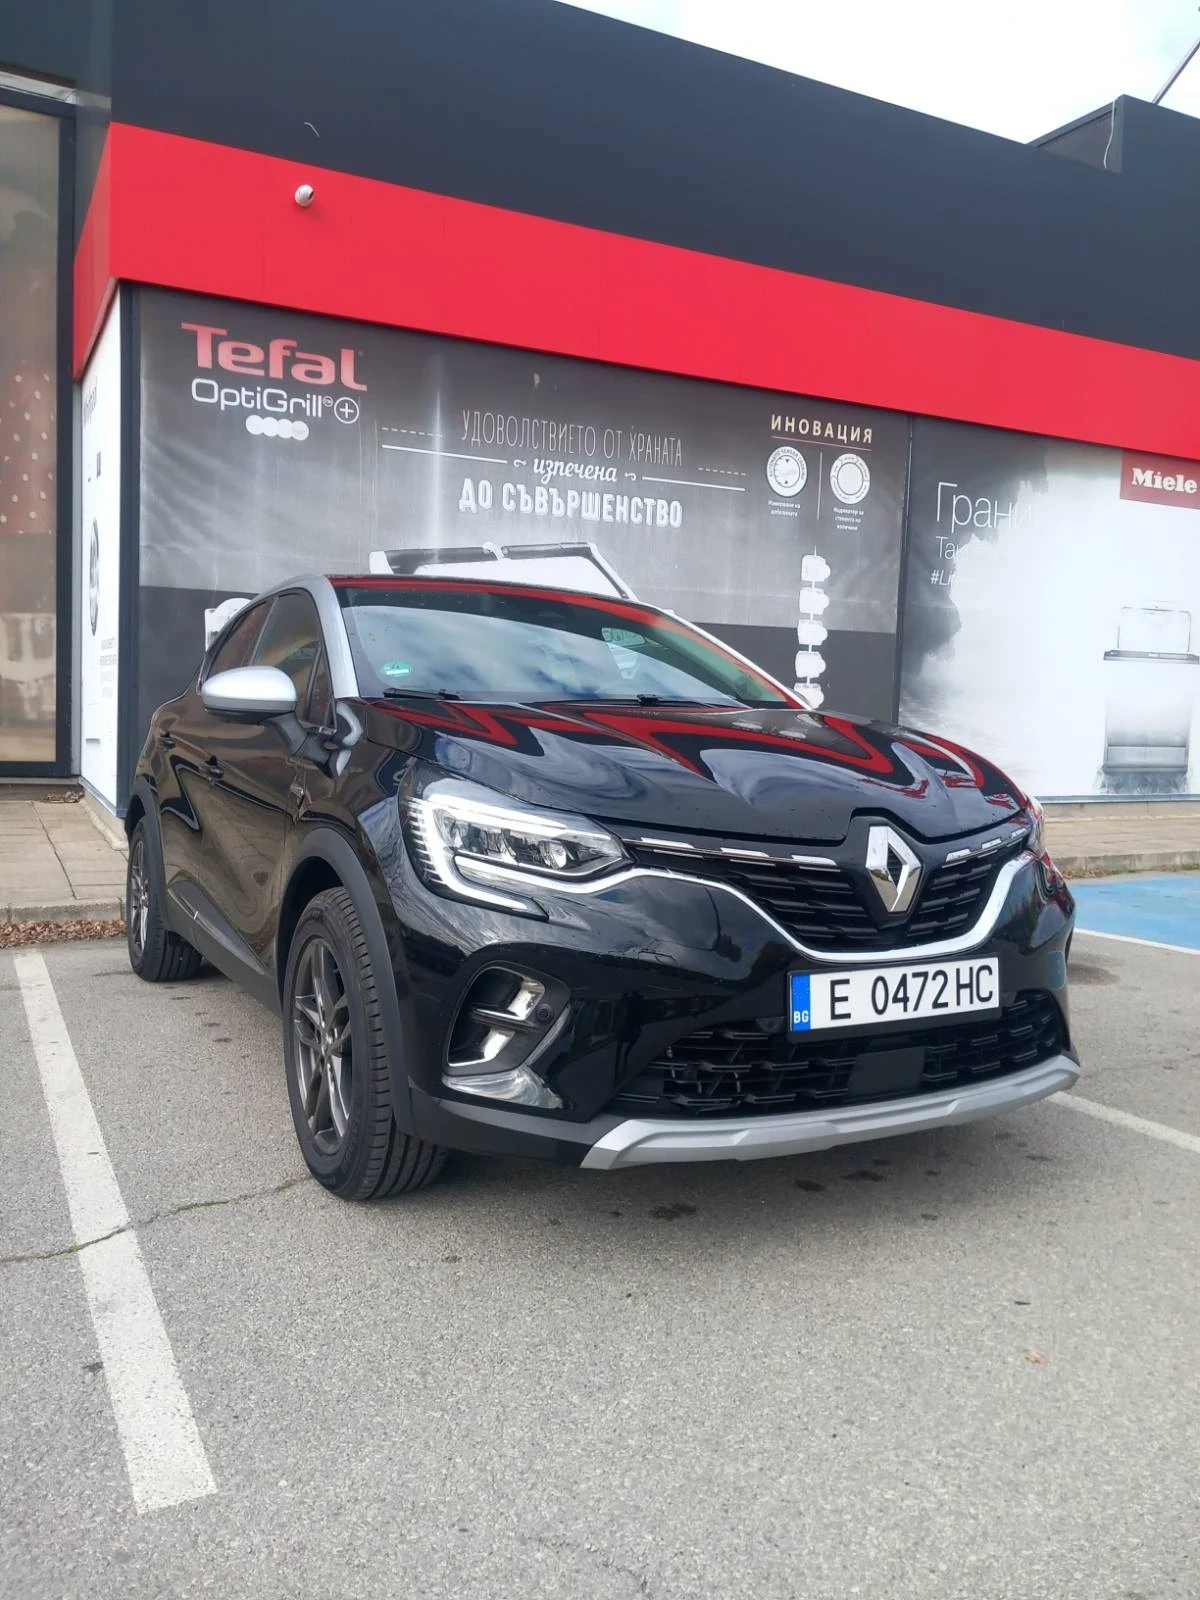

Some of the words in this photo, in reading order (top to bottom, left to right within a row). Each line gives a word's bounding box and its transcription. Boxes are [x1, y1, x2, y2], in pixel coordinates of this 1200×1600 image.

[181, 322, 367, 392] Tefal
[461, 409, 596, 457] УДОВОЛСТВИЕТО
[603, 429, 623, 459] ОТ
[629, 430, 683, 466] ХРАНАТА
[770, 414, 873, 444] ИНОВАЦИЯ
[533, 458, 618, 485] изпечена
[1131, 468, 1197, 494] Miele
[459, 478, 493, 514] ДО
[502, 482, 683, 528] СЪВЪРШЕНСТВО
[793, 1010, 809, 1023] BG
[829, 978, 852, 1020] E
